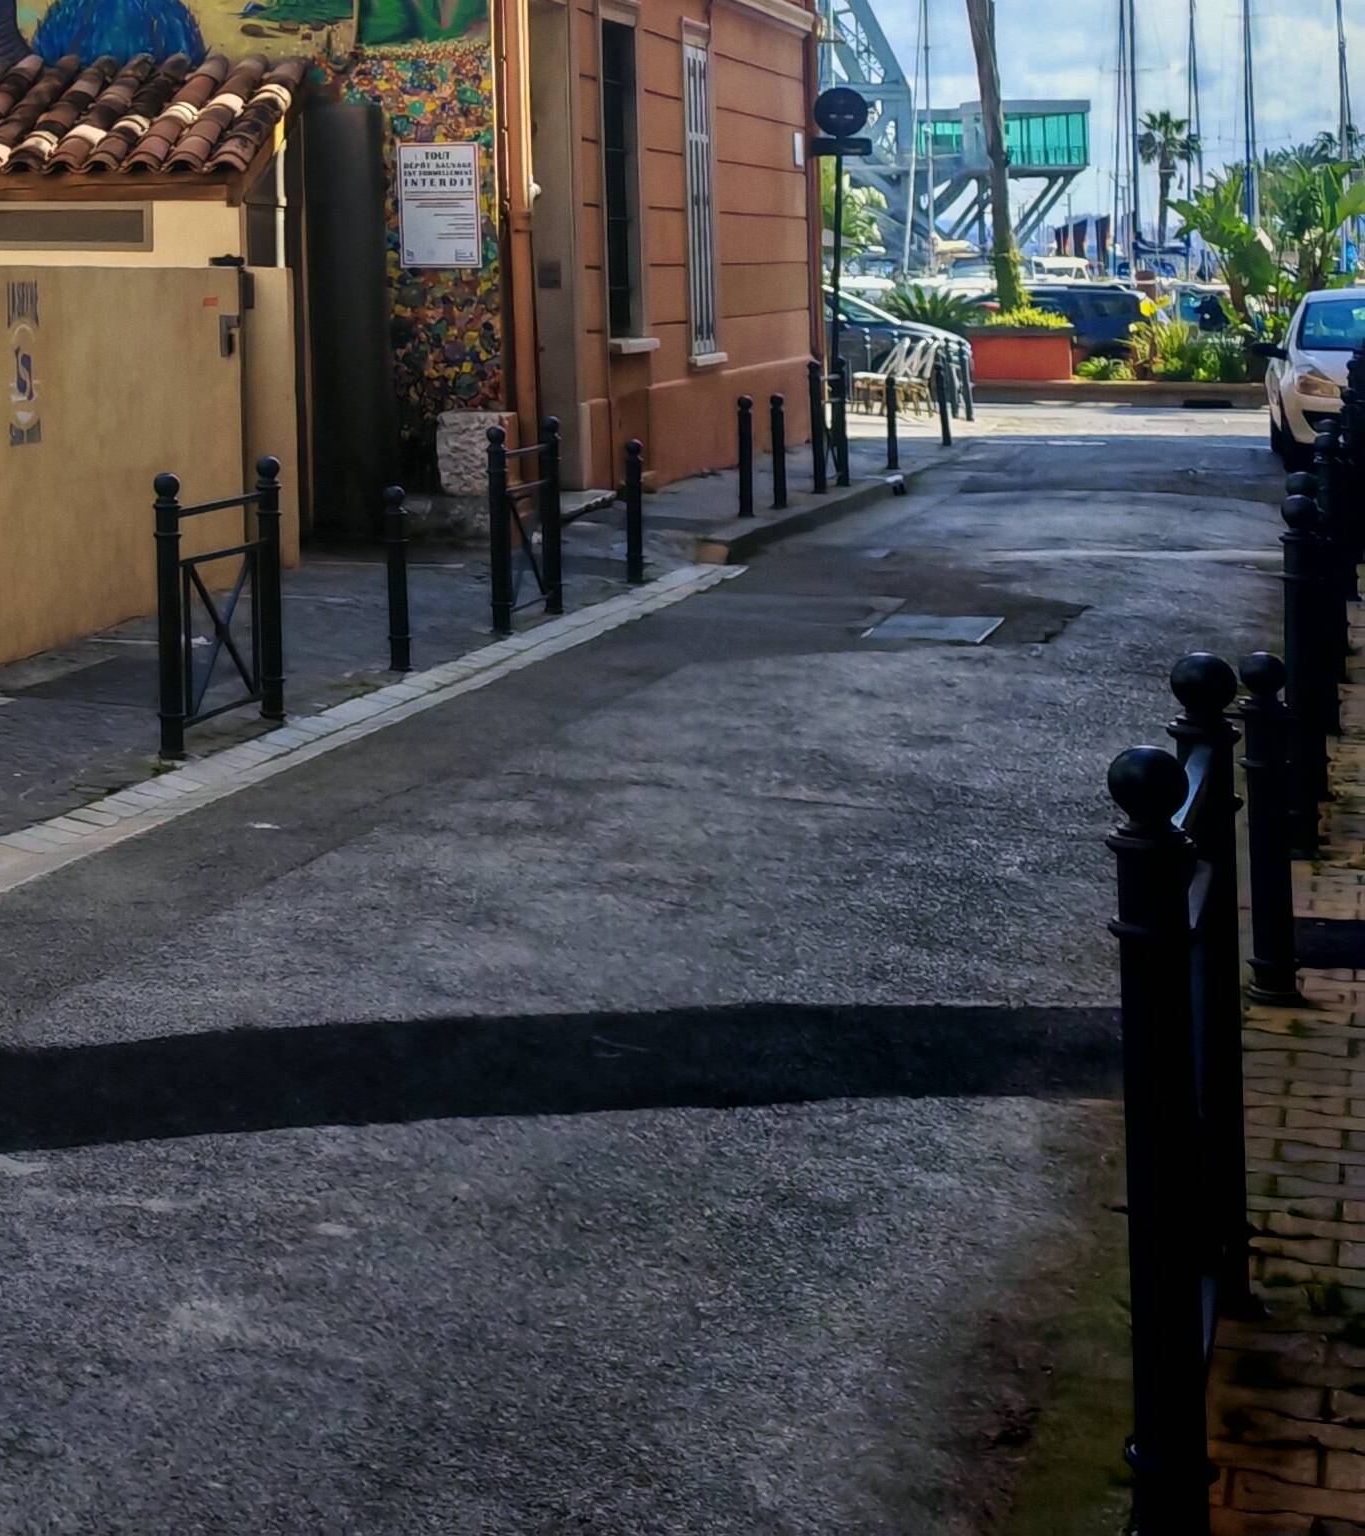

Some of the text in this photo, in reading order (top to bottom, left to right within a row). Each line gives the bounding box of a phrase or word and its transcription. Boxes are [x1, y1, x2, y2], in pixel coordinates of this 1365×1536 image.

[425, 151, 451, 160] TOUT
[435, 161, 473, 169] SAUVAGE
[403, 169, 417, 177] EST
[404, 177, 473, 188] INTERDIT
